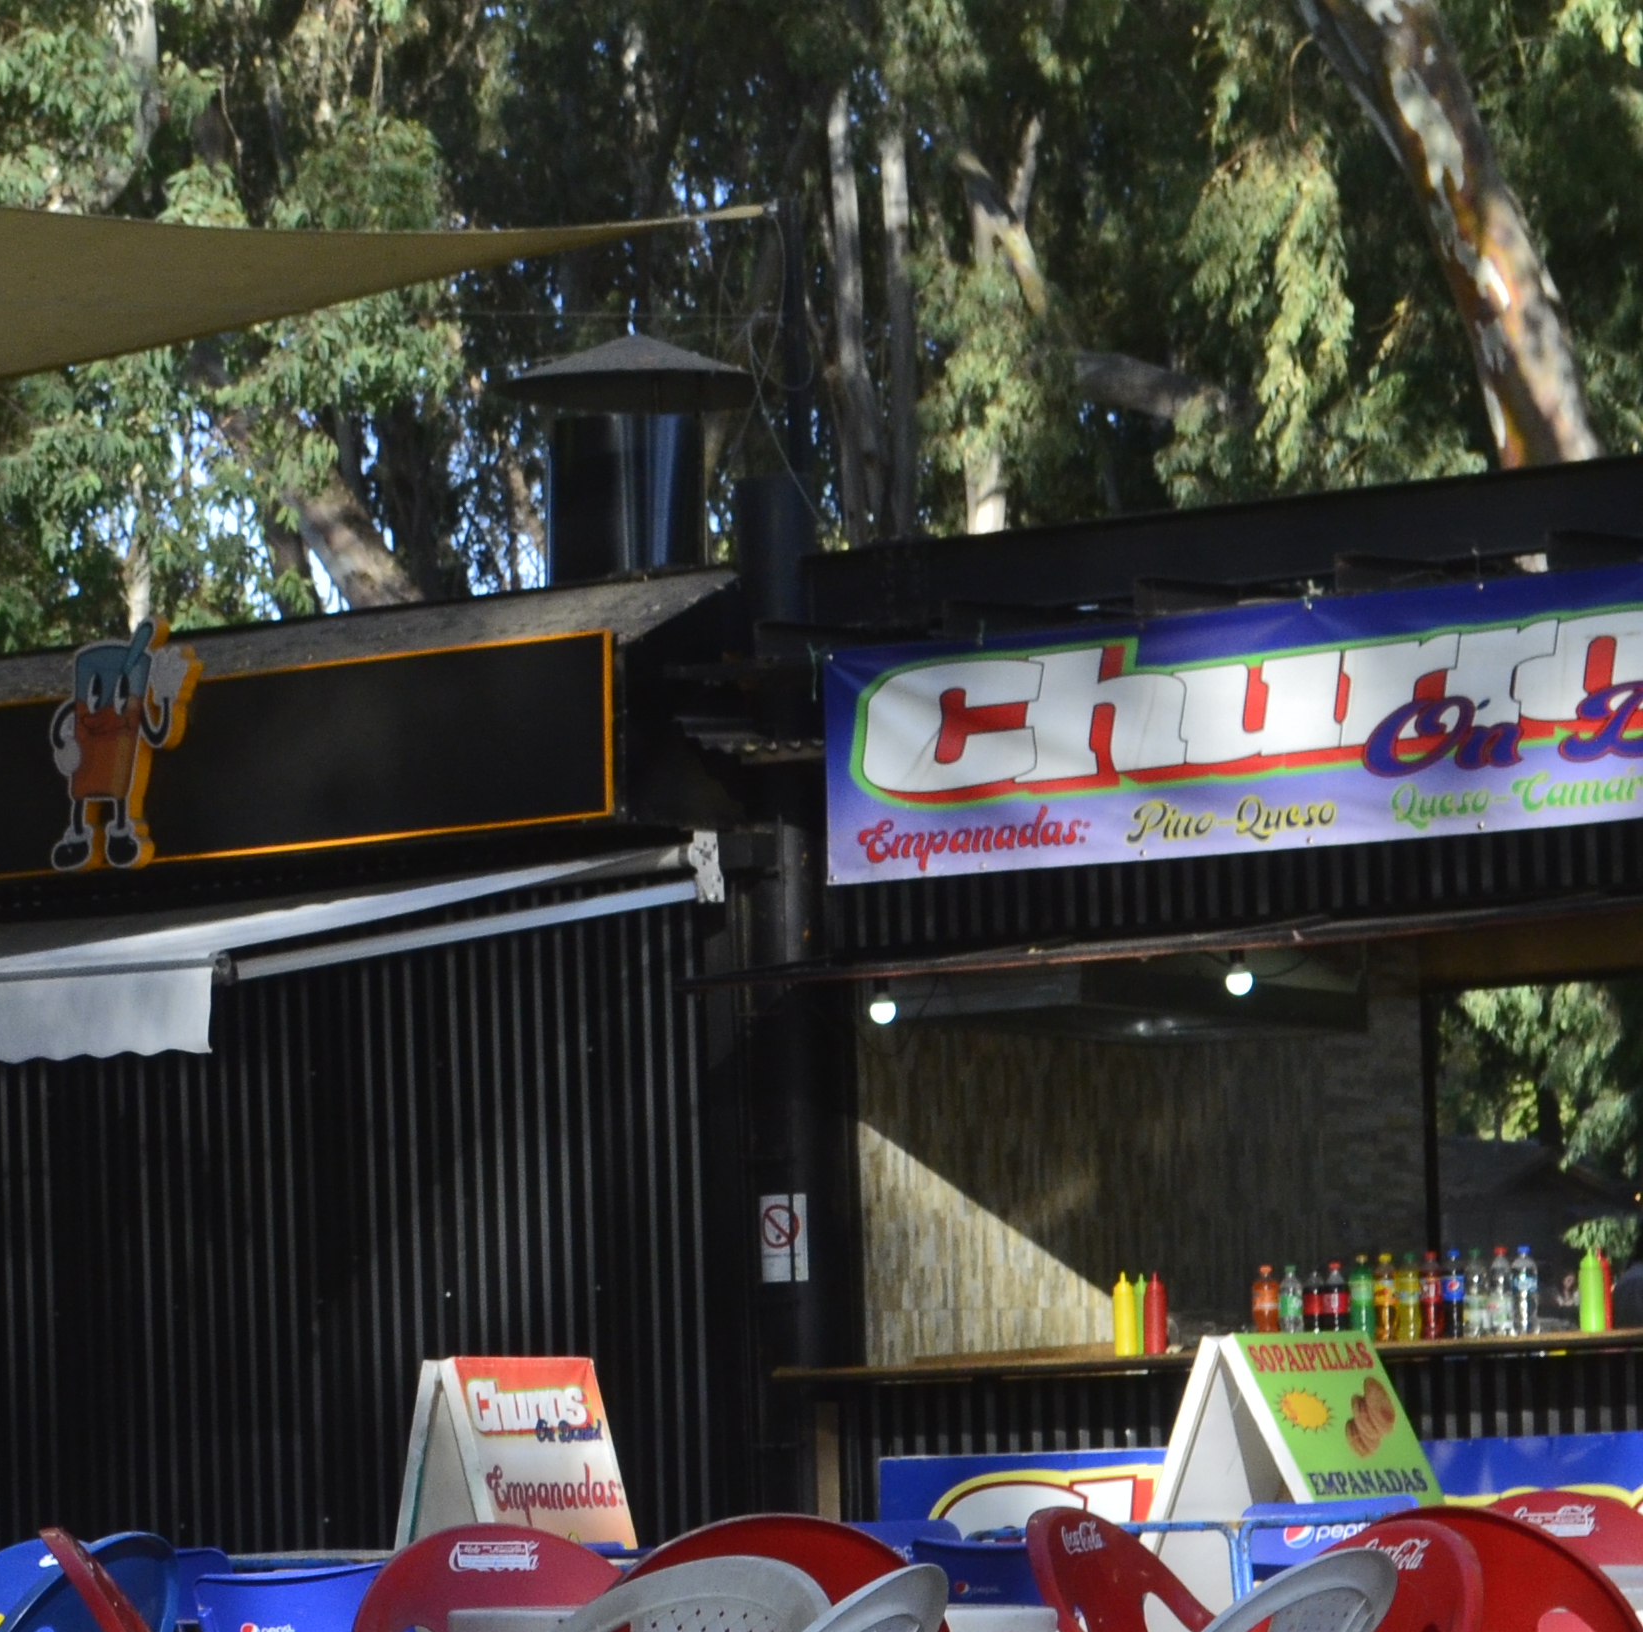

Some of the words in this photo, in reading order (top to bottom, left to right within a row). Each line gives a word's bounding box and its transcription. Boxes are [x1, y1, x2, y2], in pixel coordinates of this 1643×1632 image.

[857, 803, 1091, 871] Empanadas:
[1248, 1340, 1374, 1372] SOPAIPILLAS
[467, 1379, 588, 1433] Churros
[486, 1462, 625, 1527] Empanadas:
[1308, 1468, 1429, 1496] EMPANADAS
